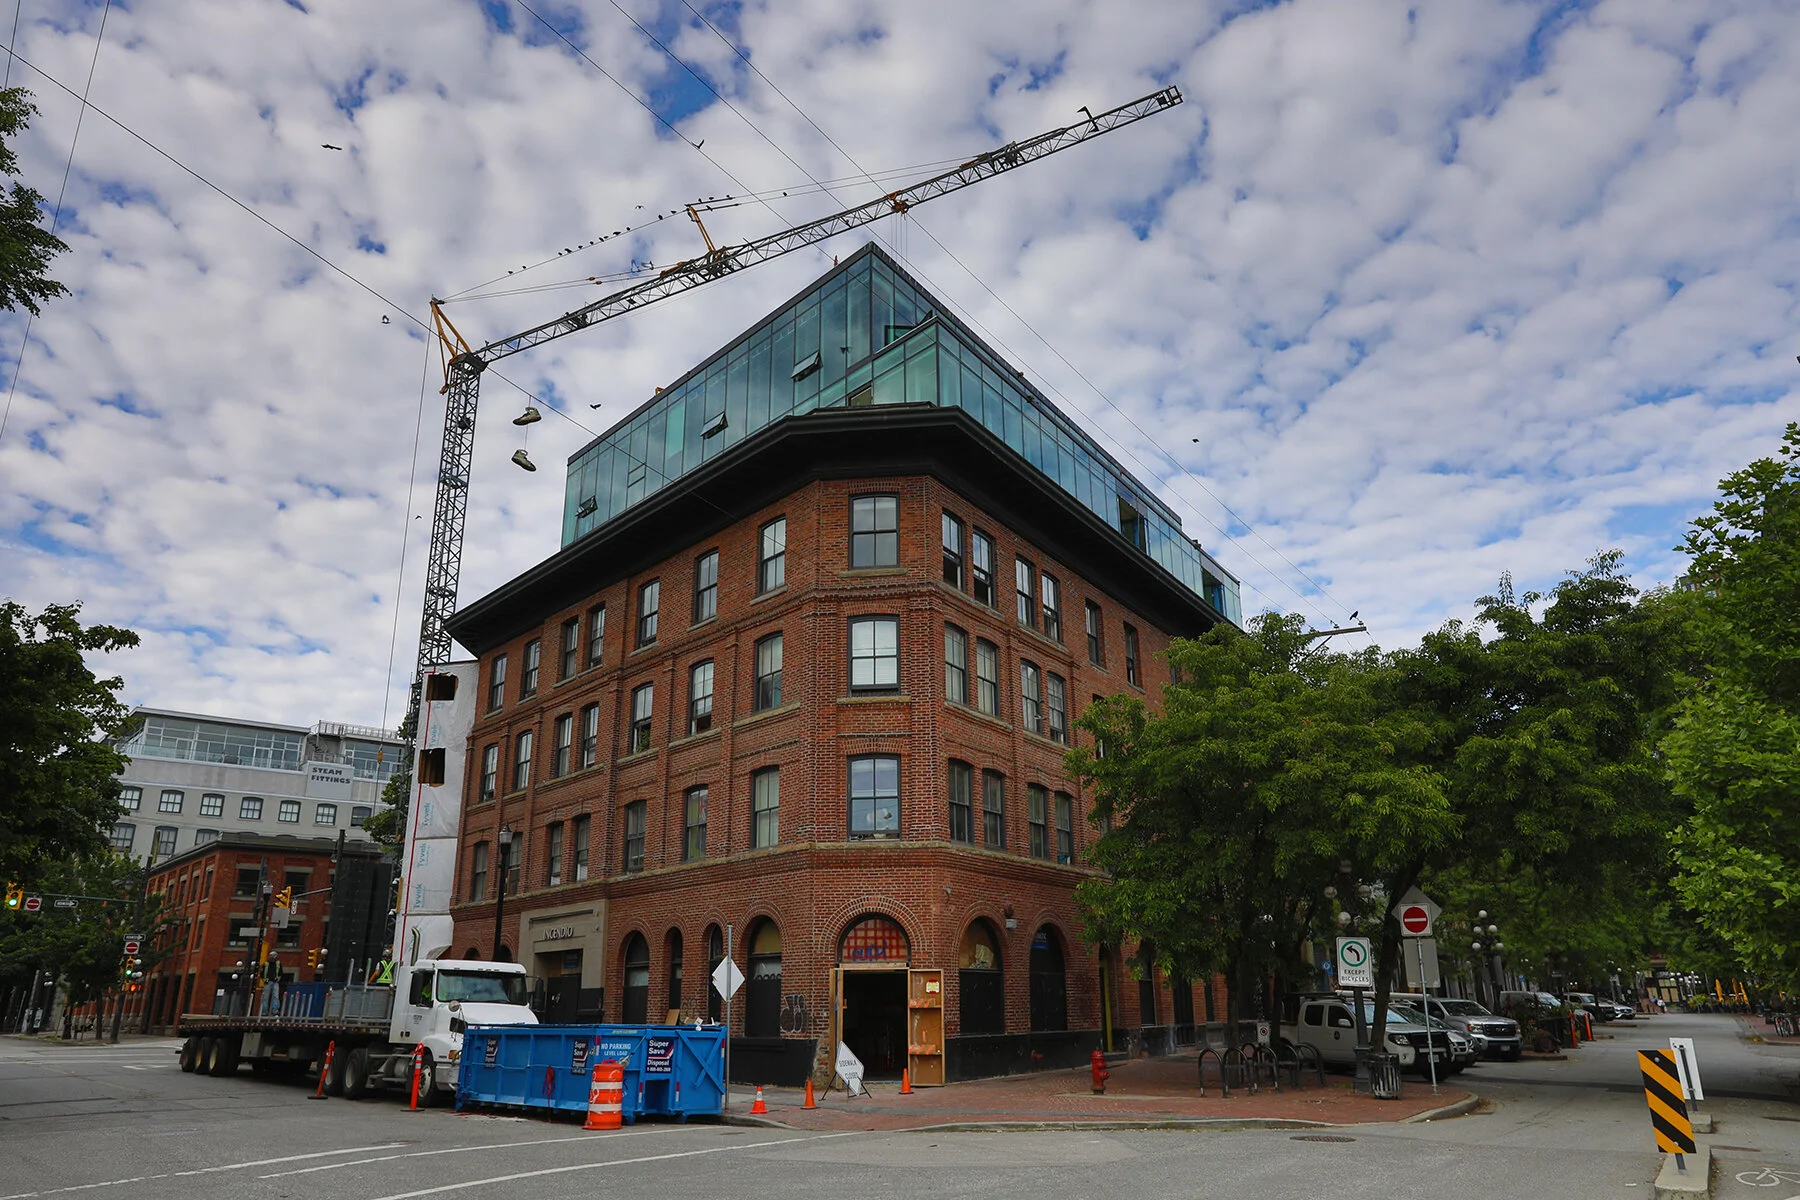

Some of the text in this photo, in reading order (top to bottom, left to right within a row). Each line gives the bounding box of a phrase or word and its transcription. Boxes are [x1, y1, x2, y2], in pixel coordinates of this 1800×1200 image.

[312, 767, 342, 775] STEAM
[311, 775, 351, 784] FITTINGS
[421, 802, 431, 828] Tyvek
[417, 843, 427, 868] Tyvek
[413, 883, 423, 909] Tyvek
[542, 926, 574, 940] INCENDIO
[648, 1040, 669, 1048] Super
[647, 1059, 670, 1067] Disposal
